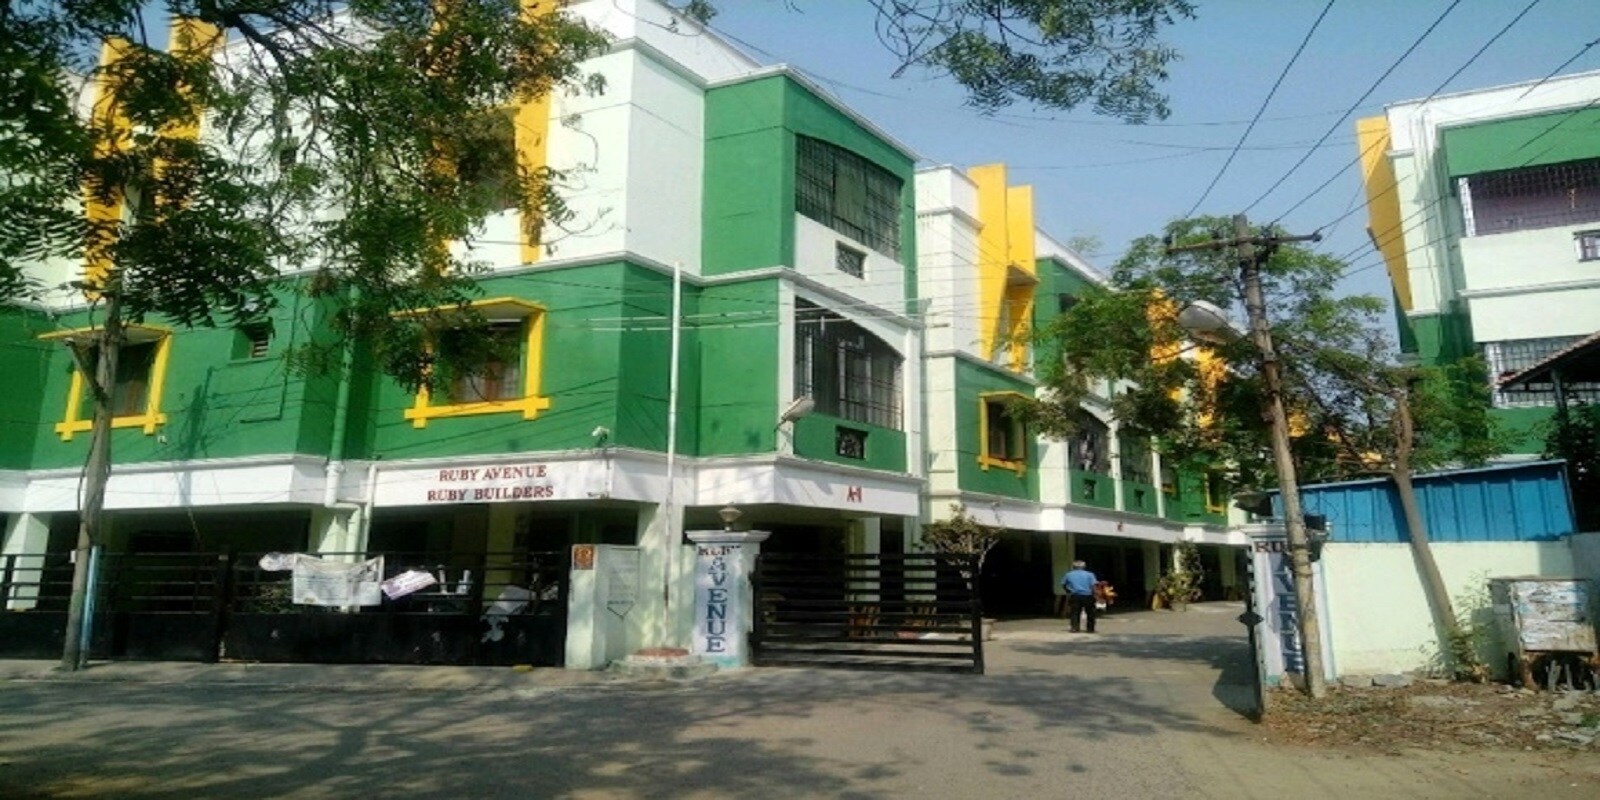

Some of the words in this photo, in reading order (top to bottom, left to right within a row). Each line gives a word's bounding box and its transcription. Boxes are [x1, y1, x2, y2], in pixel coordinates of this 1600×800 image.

[439, 469, 480, 481] RUBY
[482, 465, 547, 480] AVENUE
[427, 488, 467, 501] RUBY
[474, 485, 554, 500] BUILDERS
[1255, 541, 1287, 553] RU
[706, 556, 729, 653] AVENUE
